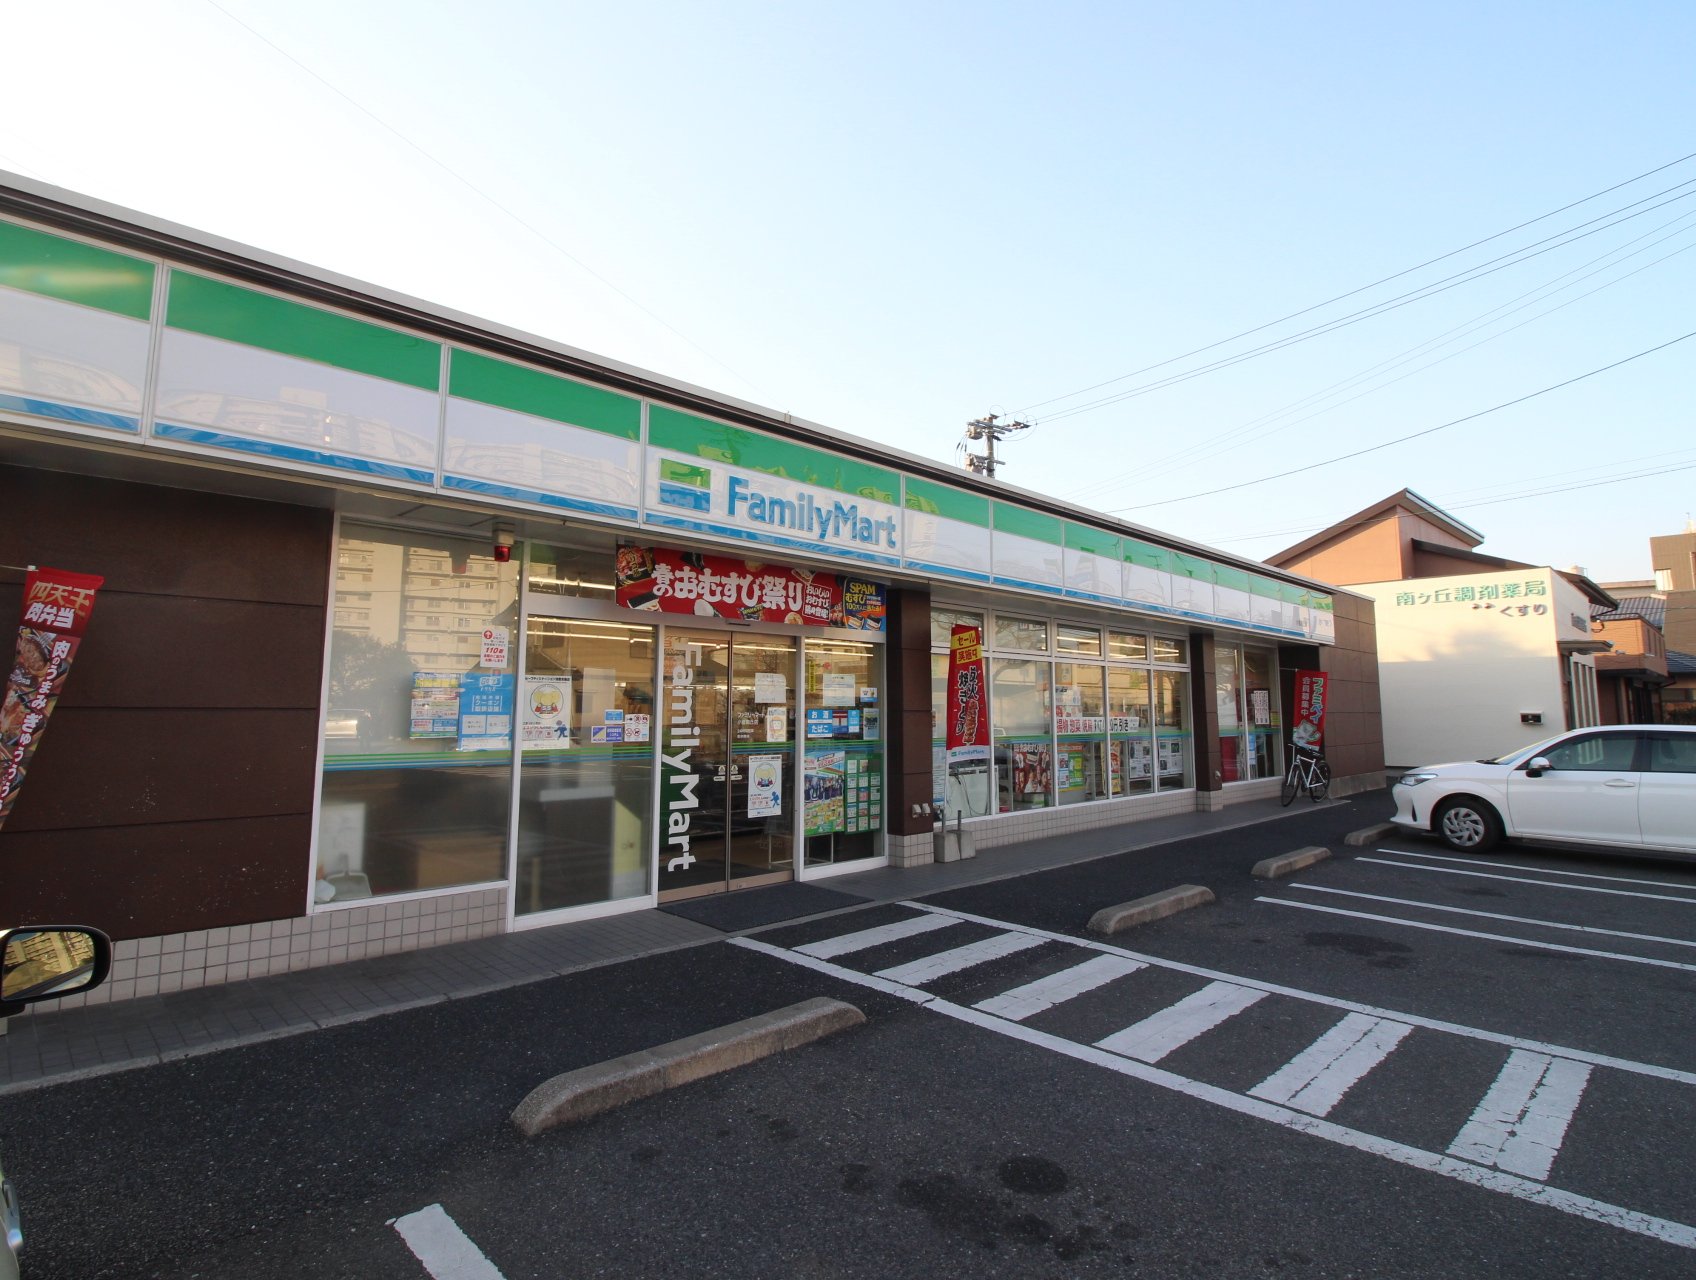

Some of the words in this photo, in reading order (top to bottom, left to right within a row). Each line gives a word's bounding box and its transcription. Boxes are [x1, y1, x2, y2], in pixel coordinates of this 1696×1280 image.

[727, 475, 897, 549] FamilyMart
[651, 562, 803, 611] 春のおむすび祭り
[849, 582, 876, 595] SPAM
[27, 581, 95, 618] 四天王
[845, 592, 867, 605] むすび
[24, 602, 76, 629] 肉弁当
[1499, 603, 1548, 618] くすり
[957, 634, 976, 647] セール
[1310, 677, 1325, 724] ファミペイ
[811, 710, 829, 719] お酒
[811, 724, 829, 733] たばこ
[661, 643, 702, 873] FamilyMart
